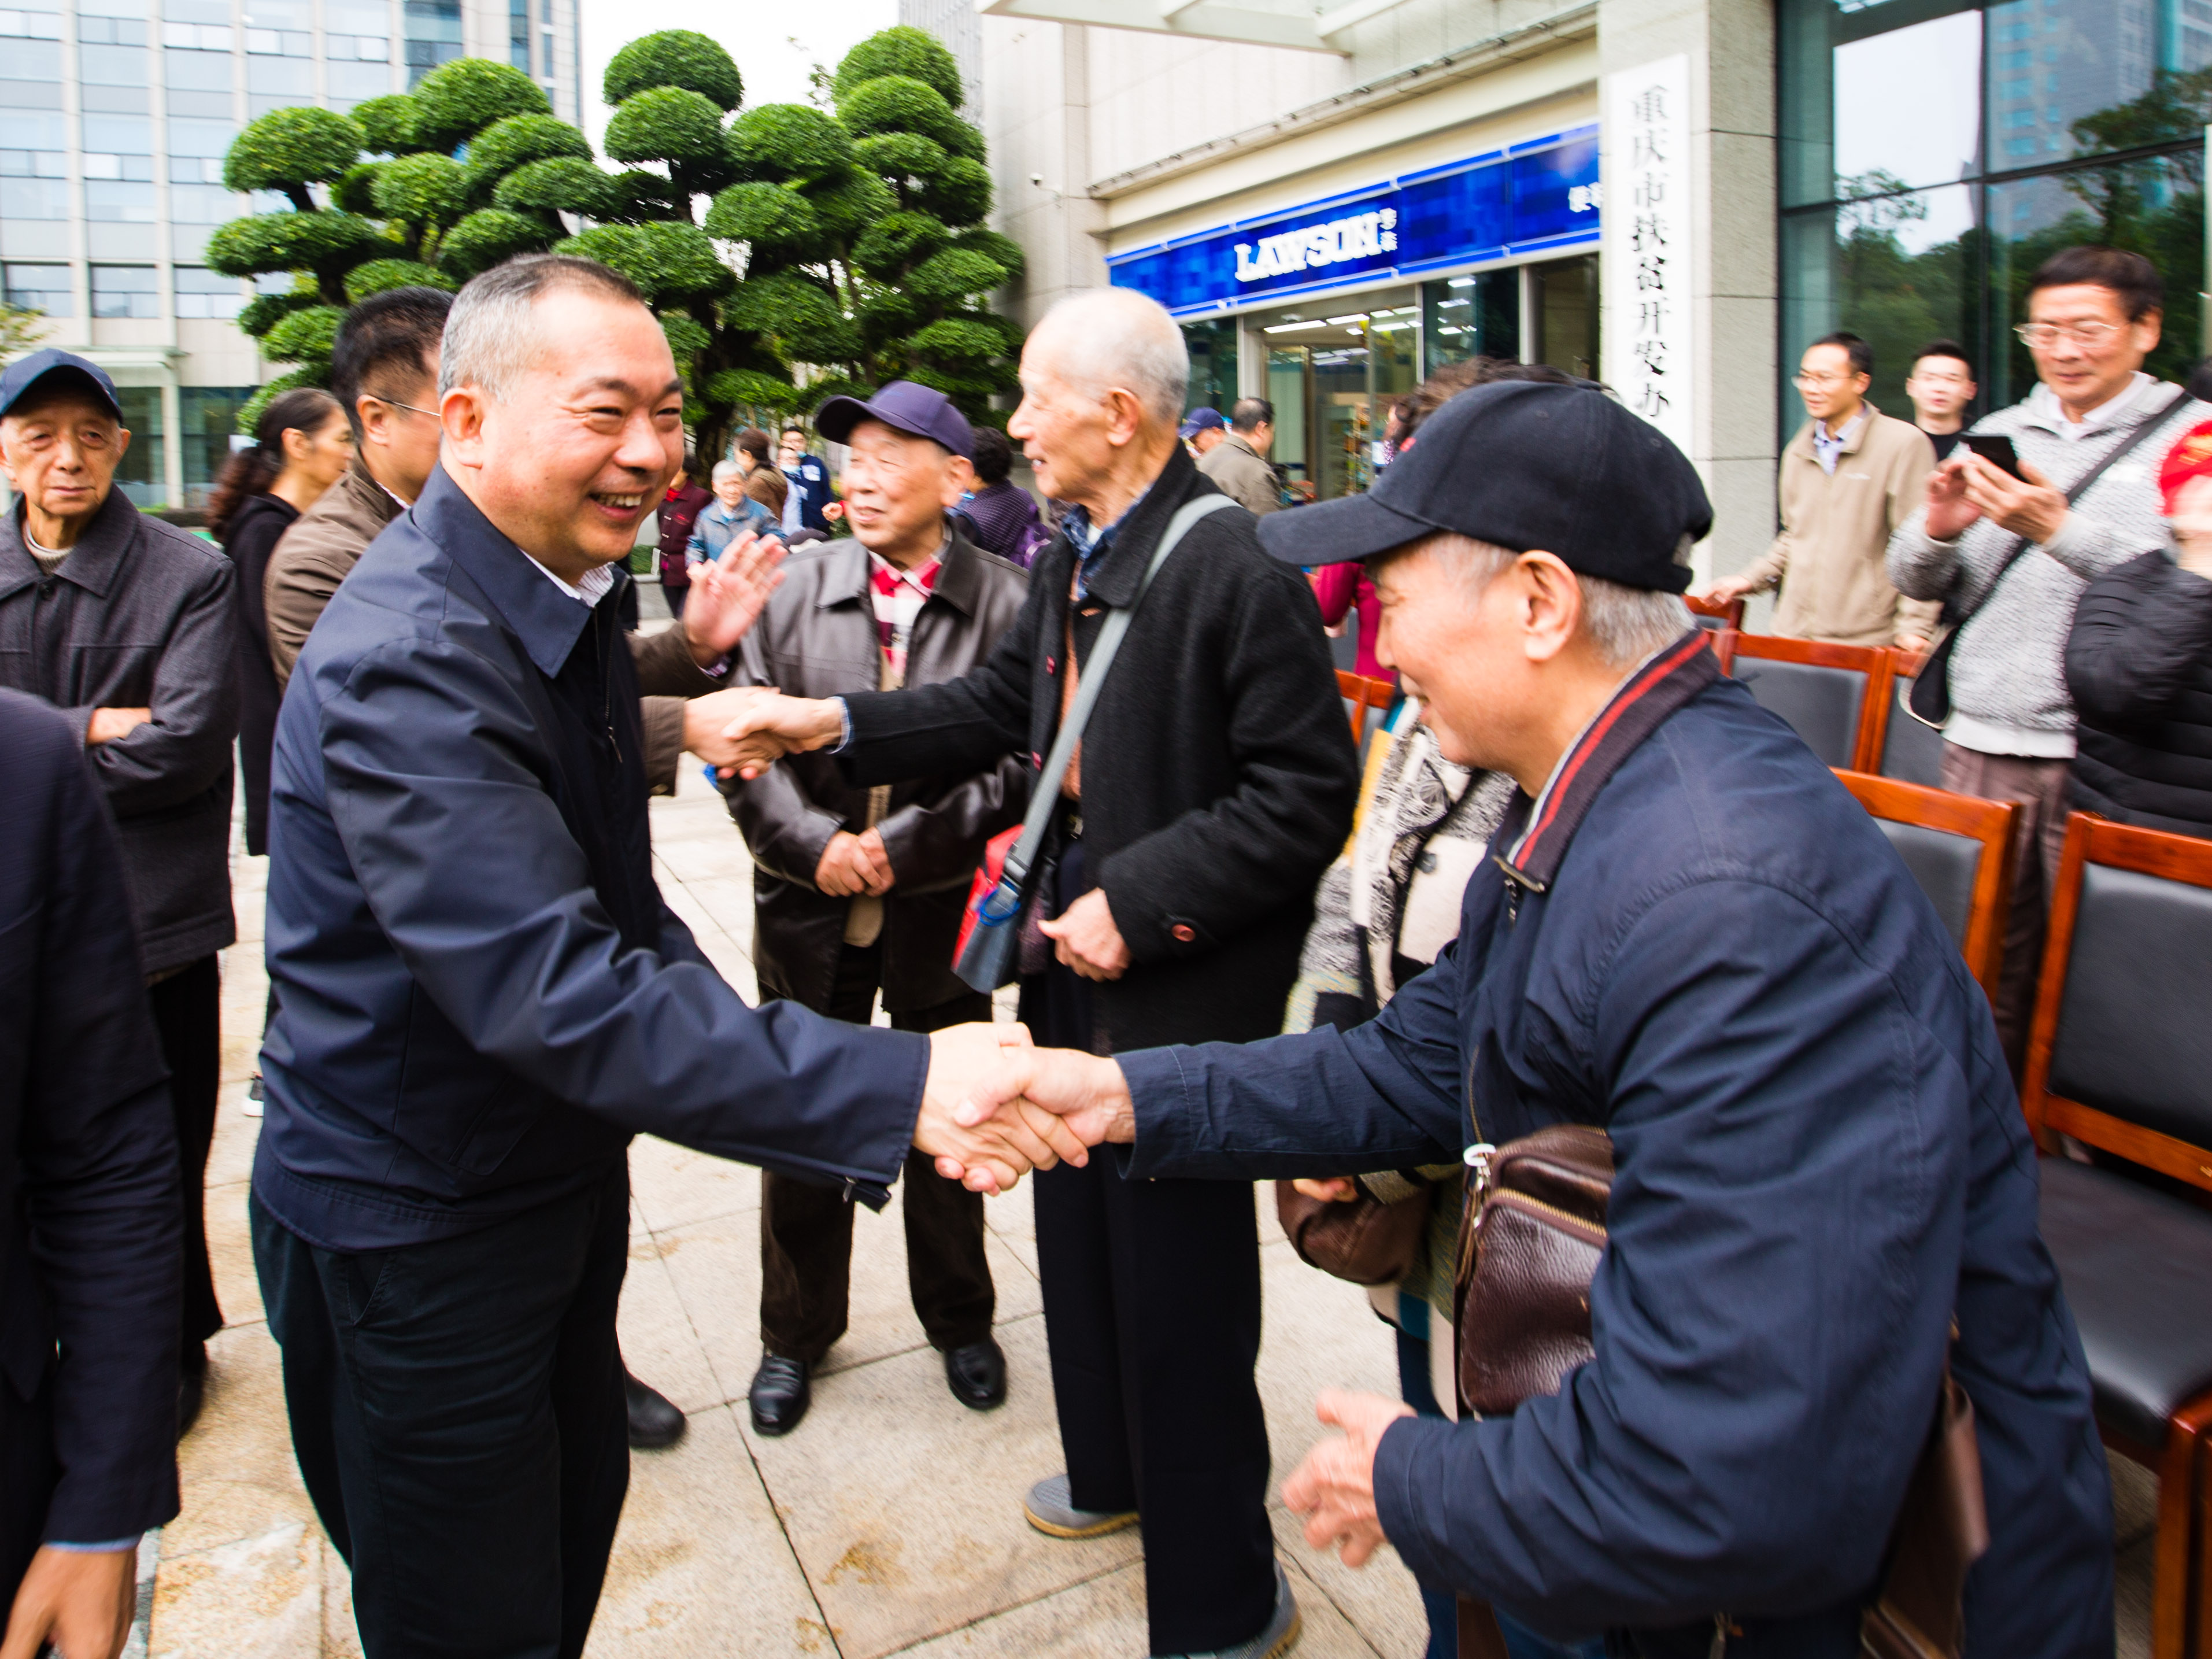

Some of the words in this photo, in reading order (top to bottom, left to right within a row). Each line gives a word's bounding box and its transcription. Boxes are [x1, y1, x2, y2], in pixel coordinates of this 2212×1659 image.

[1234, 211, 1382, 282] LAWSON
[1630, 85, 1671, 417] 重庆市扶贫开发办
